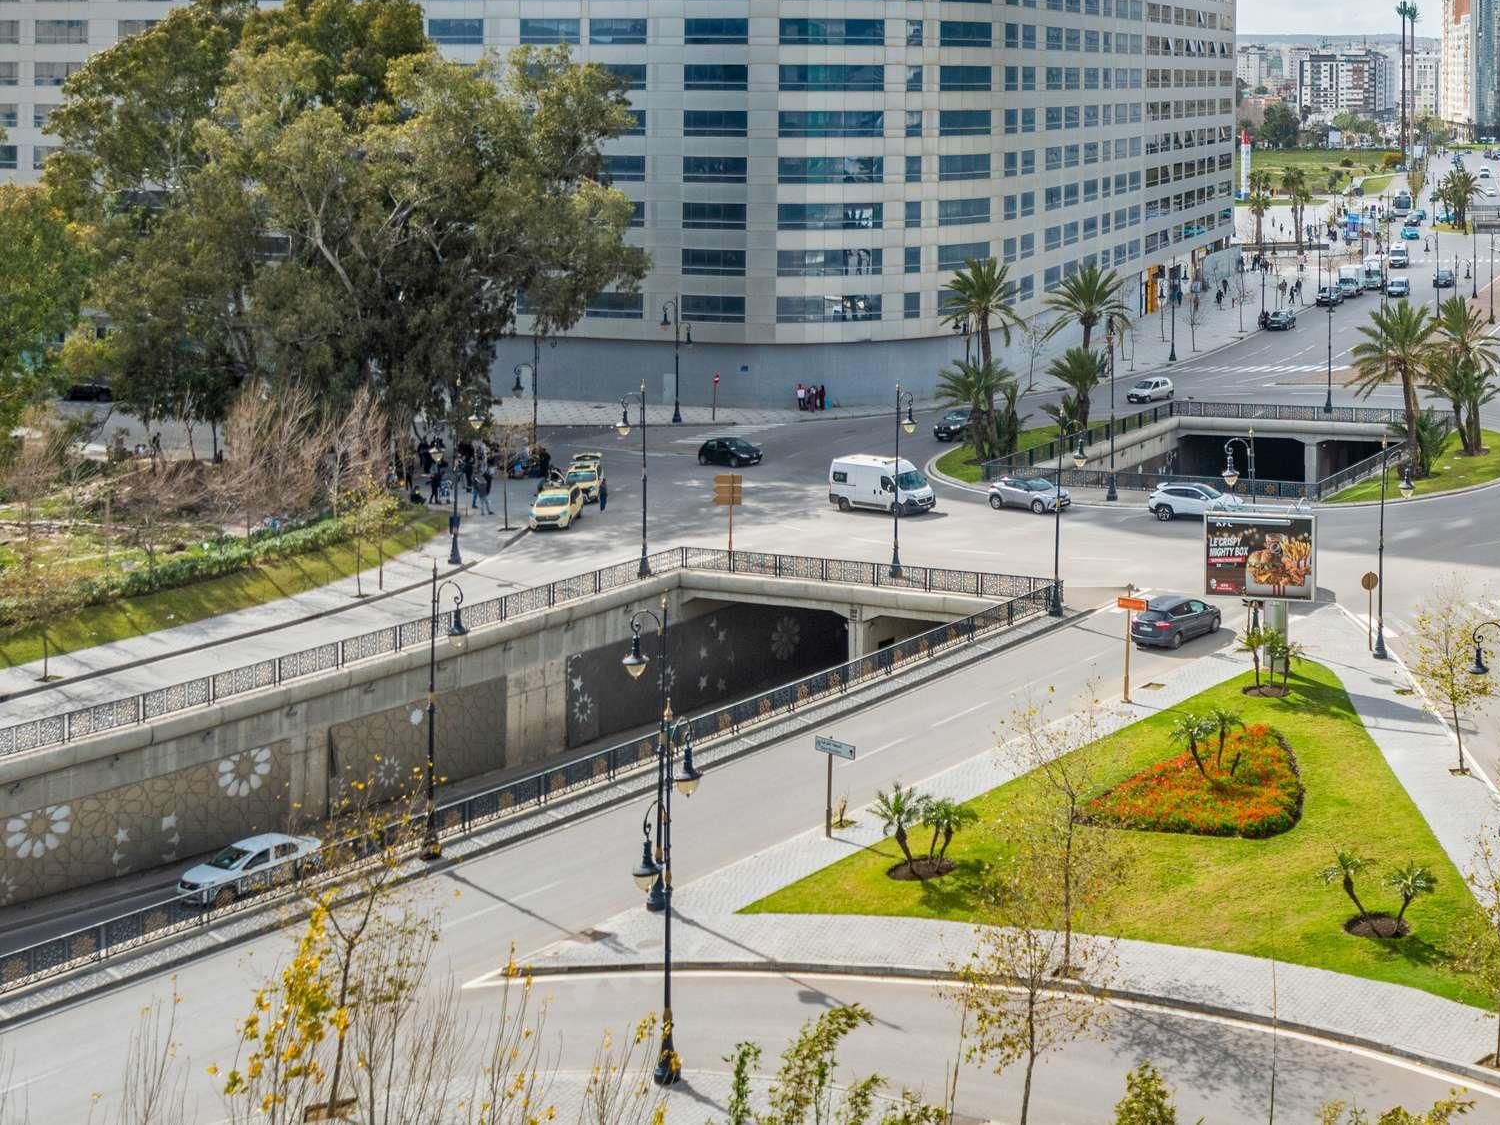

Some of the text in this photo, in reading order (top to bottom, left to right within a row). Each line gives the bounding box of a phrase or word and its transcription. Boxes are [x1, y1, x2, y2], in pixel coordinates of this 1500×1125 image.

[1209, 537, 1242, 547] LE CRISPY
[1209, 547, 1249, 557] MIGHTY BOX
